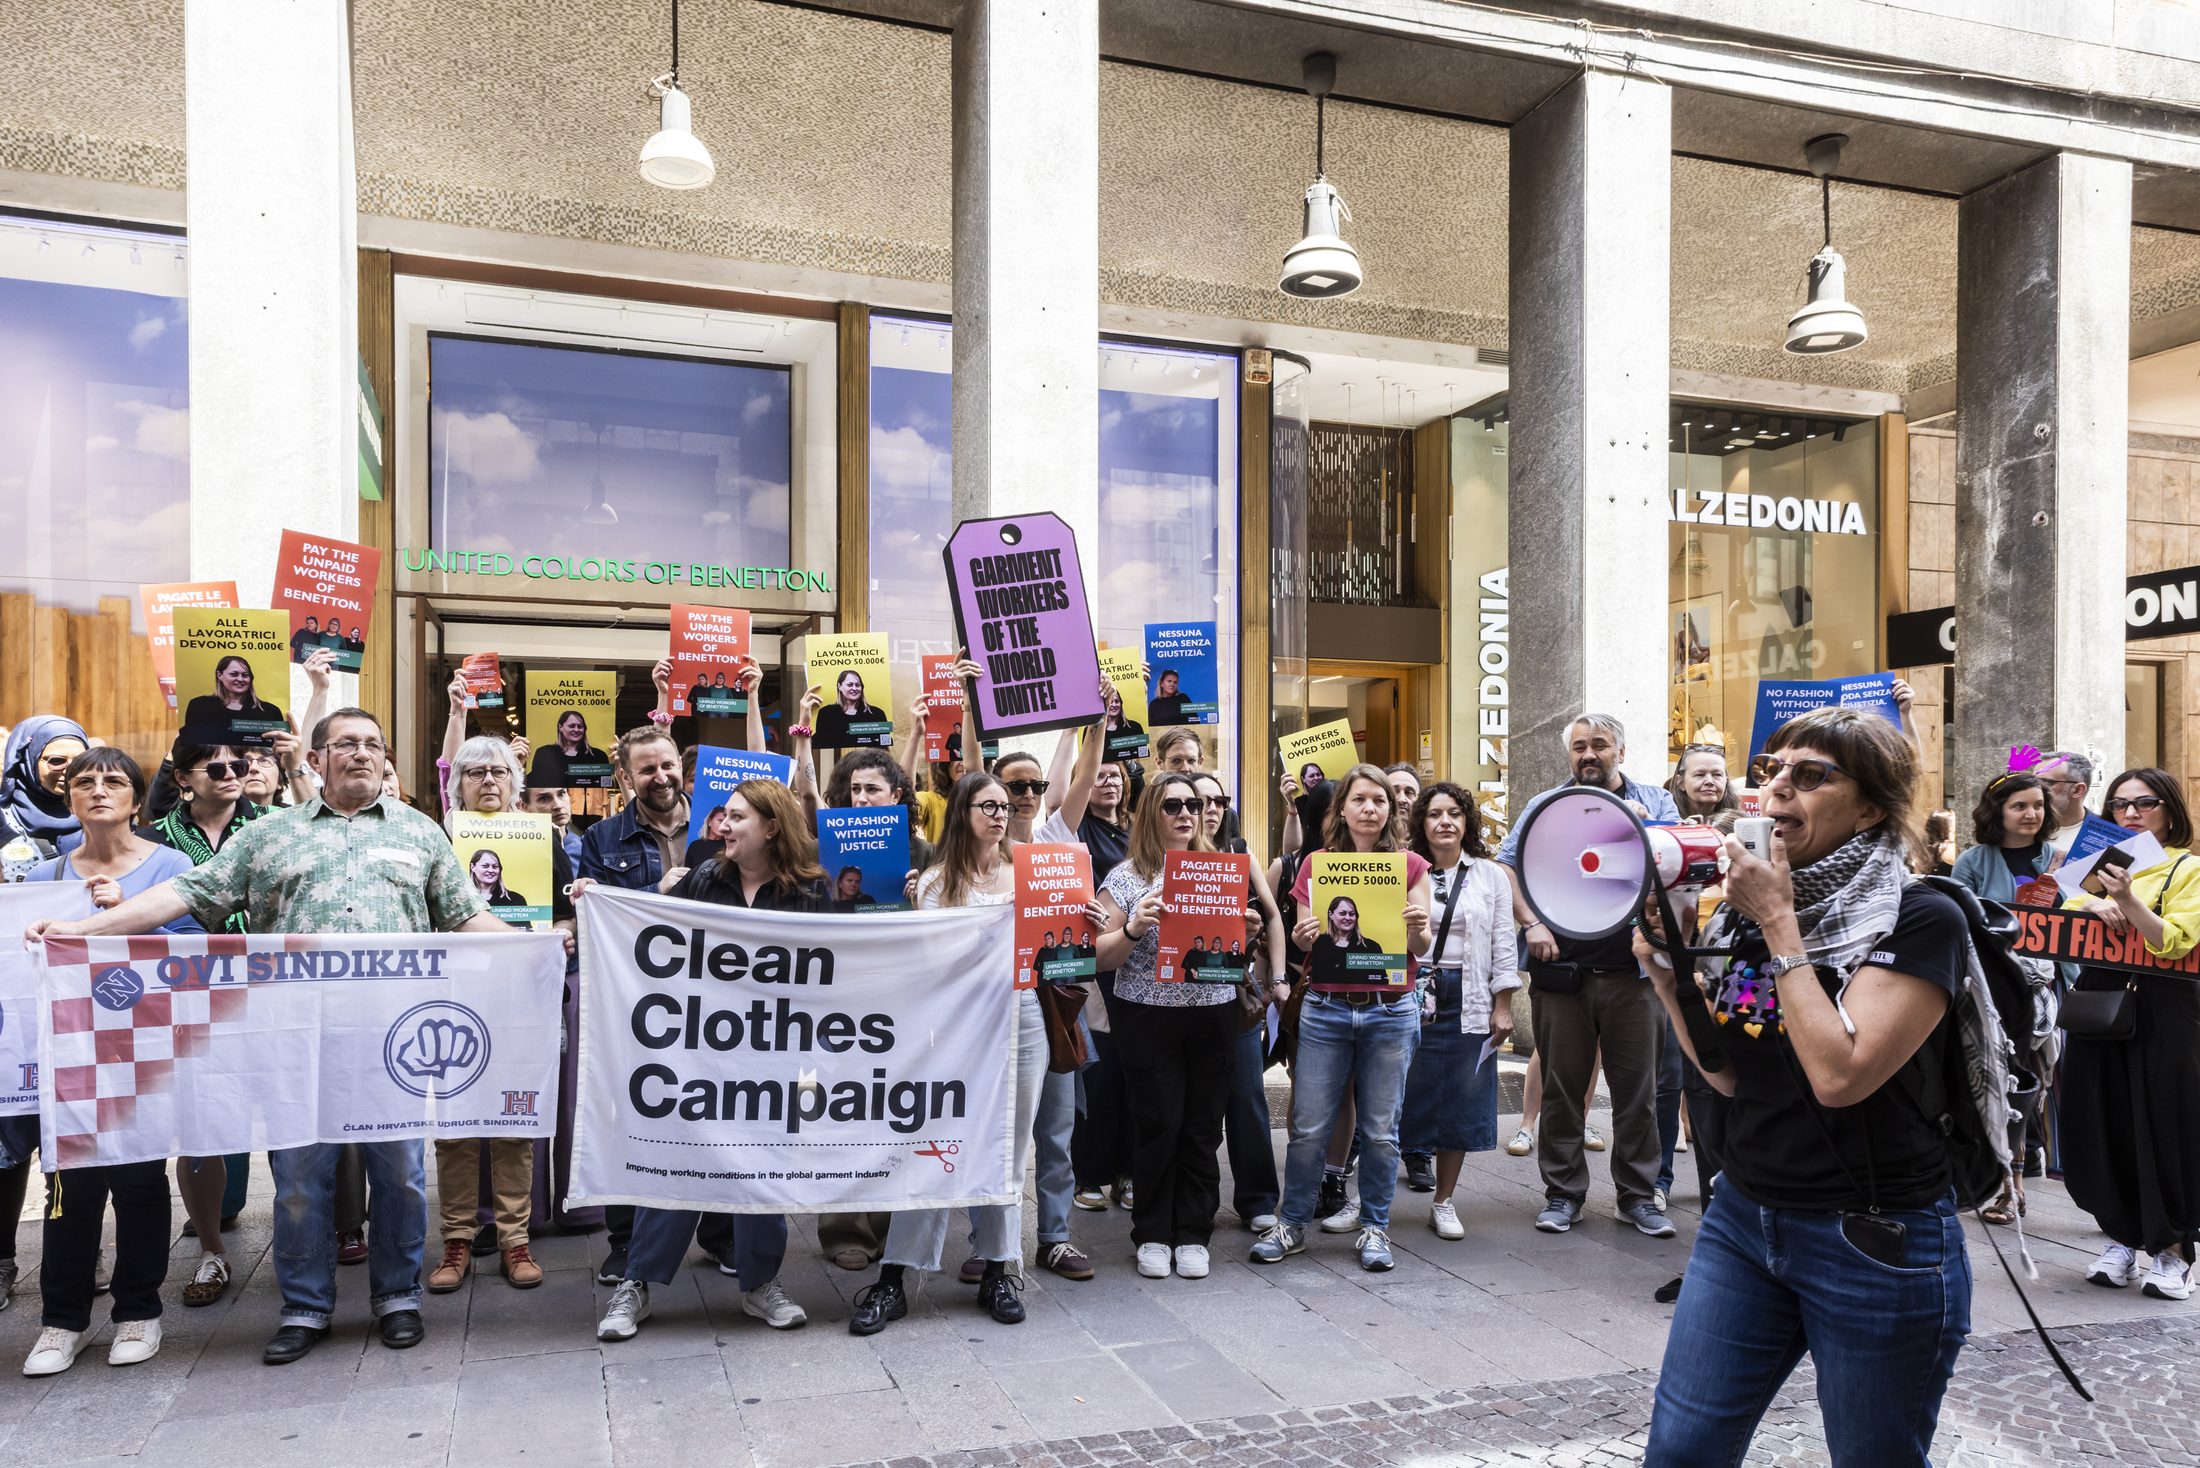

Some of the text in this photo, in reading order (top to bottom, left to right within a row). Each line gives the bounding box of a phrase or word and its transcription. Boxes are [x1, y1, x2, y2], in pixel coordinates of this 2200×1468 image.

[302, 542, 360, 563] PAY THE
[302, 556, 356, 574] UNPAID
[404, 548, 833, 592] UNITED COLORS OF BENETTON.
[969, 548, 1063, 587] GARMENT
[293, 565, 361, 587] WORKERS
[316, 582, 336, 594] OF
[157, 590, 221, 602] PAGATE LE
[284, 588, 362, 611] BENETTON.
[975, 580, 1070, 620] WORKERS
[216, 618, 248, 628] ALLE
[688, 612, 733, 624] PAY THE
[188, 629, 276, 639] LAVORATRICI
[690, 623, 731, 634] UNPAID
[982, 616, 1041, 652] OF THE
[1158, 629, 1202, 638] NESSUNA
[154, 637, 166, 646] DI
[683, 632, 737, 644] WORKERS
[1151, 639, 1211, 648] MODA SENZA
[180, 640, 284, 650] DEVONO 50.000€
[702, 644, 718, 652] OF
[678, 652, 741, 664] BENETTON.
[817, 649, 878, 658] LAVORATRICI
[1157, 649, 1205, 658] GIUSTIZIA.
[811, 657, 885, 667] DEVONO 50.000€
[987, 648, 1057, 684] WORLD
[1112, 672, 1139, 681] 50.000€
[1841, 680, 1883, 691] NESSUNA
[993, 680, 1057, 717] UNITE!
[1766, 689, 1833, 697] NO FASHION
[1863, 688, 1892, 698] SENZA
[1772, 700, 1826, 708] WITHOUT
[1290, 729, 1340, 748] WORKERS
[1287, 737, 1349, 760] OWED 50000.
[715, 756, 772, 772] NESSUNA
[703, 767, 739, 780] MODA
[469, 819, 536, 828] WORKERS
[826, 815, 899, 828] NO FASHION
[508, 832, 546, 840] 50000.
[834, 828, 892, 840] WITHOUT
[840, 841, 888, 853] JUSTICE.
[1031, 853, 1075, 864] PAY THE
[1034, 866, 1075, 877] UNPAID
[1181, 861, 1237, 872] PAGATE LE
[1327, 863, 1392, 872] WORKERS
[1172, 871, 1242, 883] LAVORATRICI
[1318, 876, 1400, 885] OWED 50000.
[1028, 878, 1082, 891] WORKERS
[1195, 884, 1220, 893] NON
[1049, 892, 1064, 902] OF
[1175, 894, 1238, 905] RETRIBUITE
[1024, 904, 1086, 918] BENETTON
[1167, 904, 1243, 916] DI BENETTON.
[634, 924, 835, 985] Clean
[156, 950, 447, 985] OVI SINDIKAT
[630, 992, 895, 1054] Clothes
[628, 1063, 966, 1134] Campaign
[343, 1119, 539, 1132] ČLAN HRVATSKE UDRUGE SINDIKATA
[626, 1162, 890, 1181] Improving working conditions in the global garment industry
